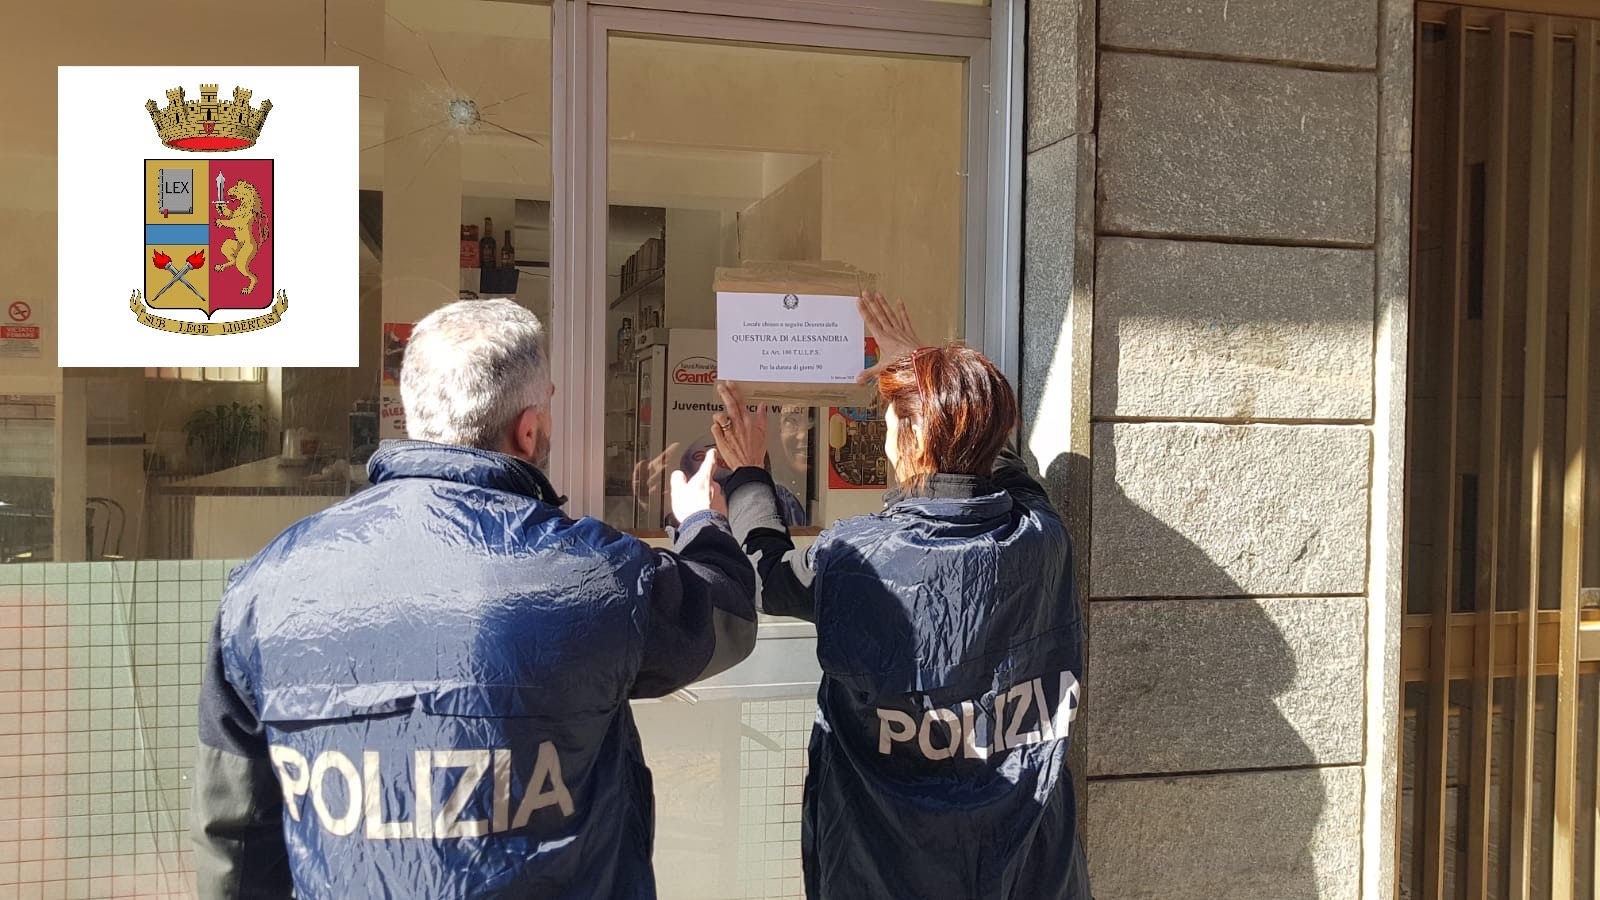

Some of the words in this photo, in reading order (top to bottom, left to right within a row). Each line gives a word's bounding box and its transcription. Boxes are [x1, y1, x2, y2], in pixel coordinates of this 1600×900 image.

[732, 334, 778, 343] QUESTURA
[672, 401, 724, 412] Juventus
[876, 670, 1081, 761] POLIZIA
[269, 740, 575, 839] POLIZIA
